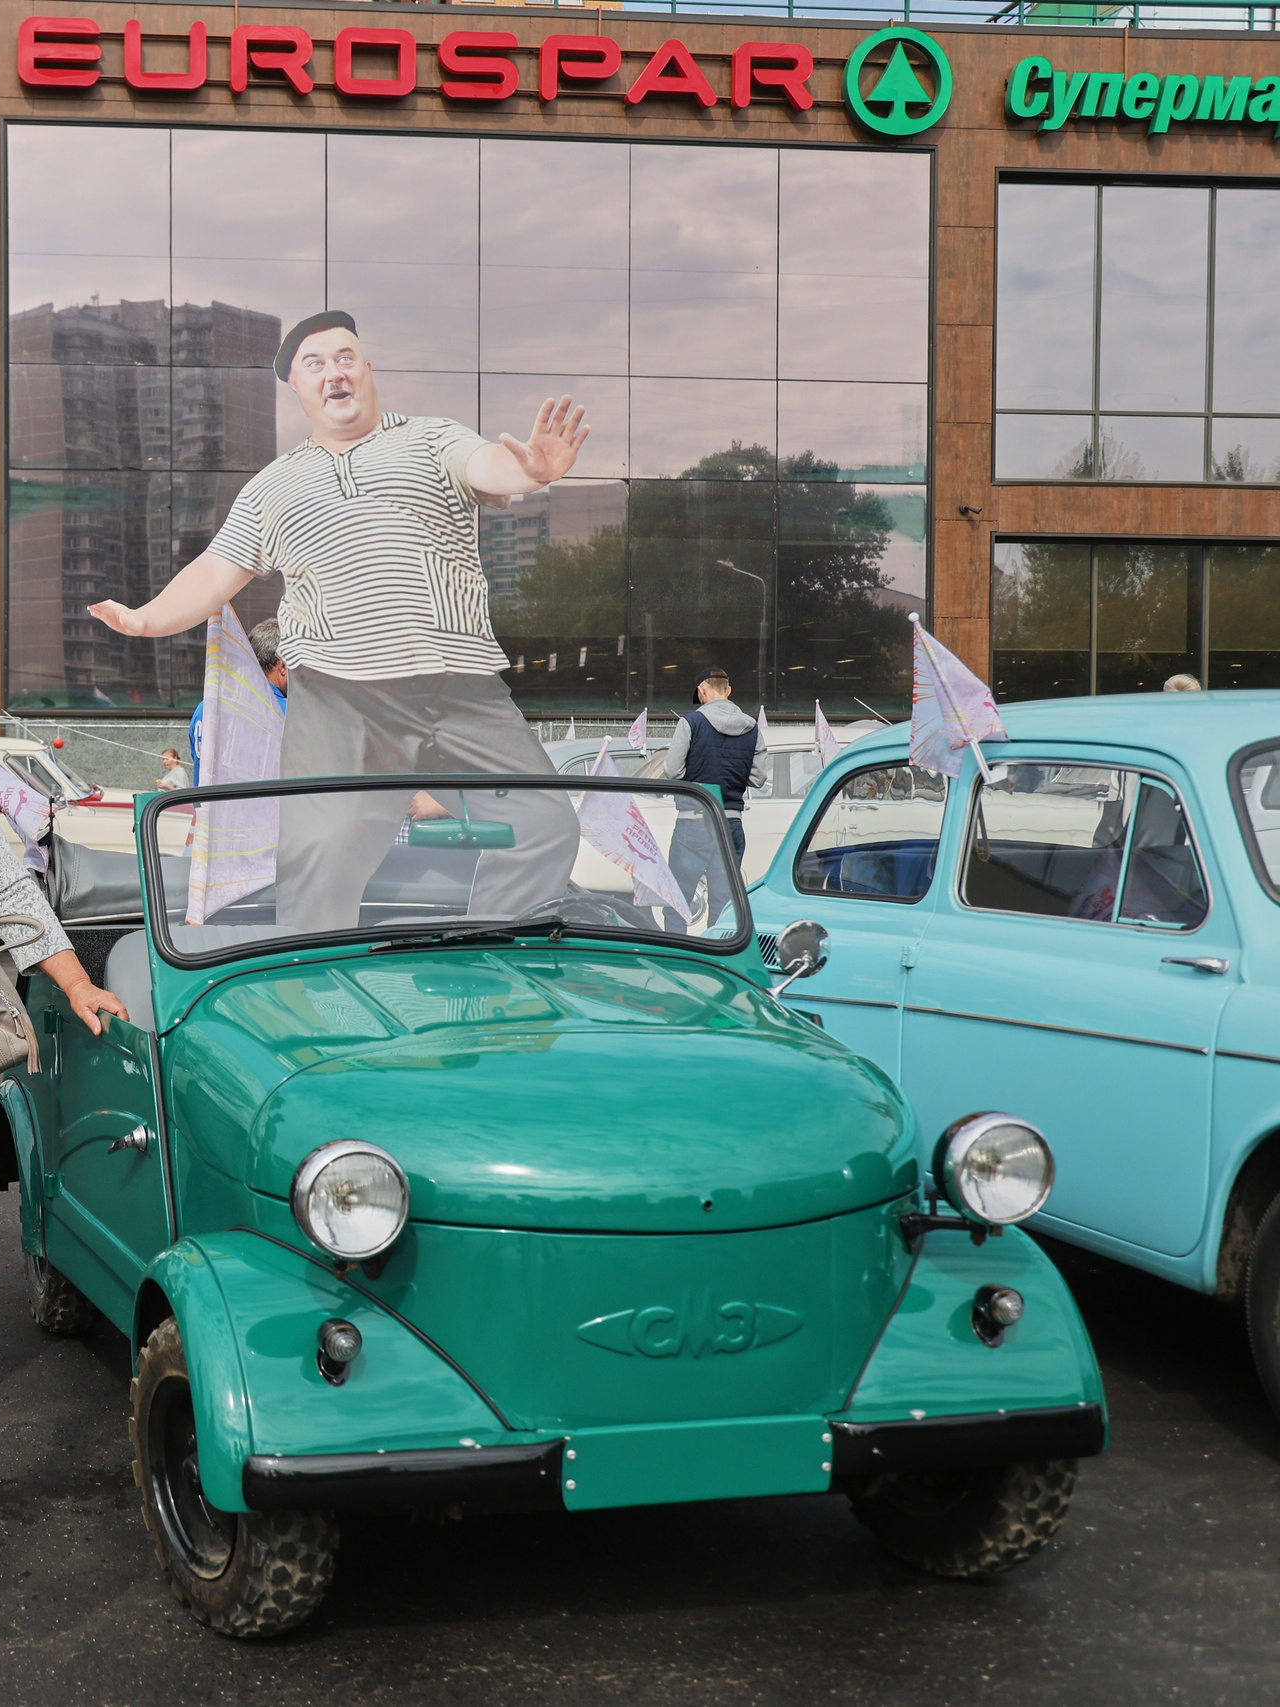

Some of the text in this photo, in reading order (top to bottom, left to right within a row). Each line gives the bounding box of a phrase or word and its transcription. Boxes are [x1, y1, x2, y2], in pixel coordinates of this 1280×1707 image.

[17, 16, 815, 111] EUROSPAR
[1006, 55, 1280, 136] Суперма
[625, 827, 660, 857] ПРОБЕГ
